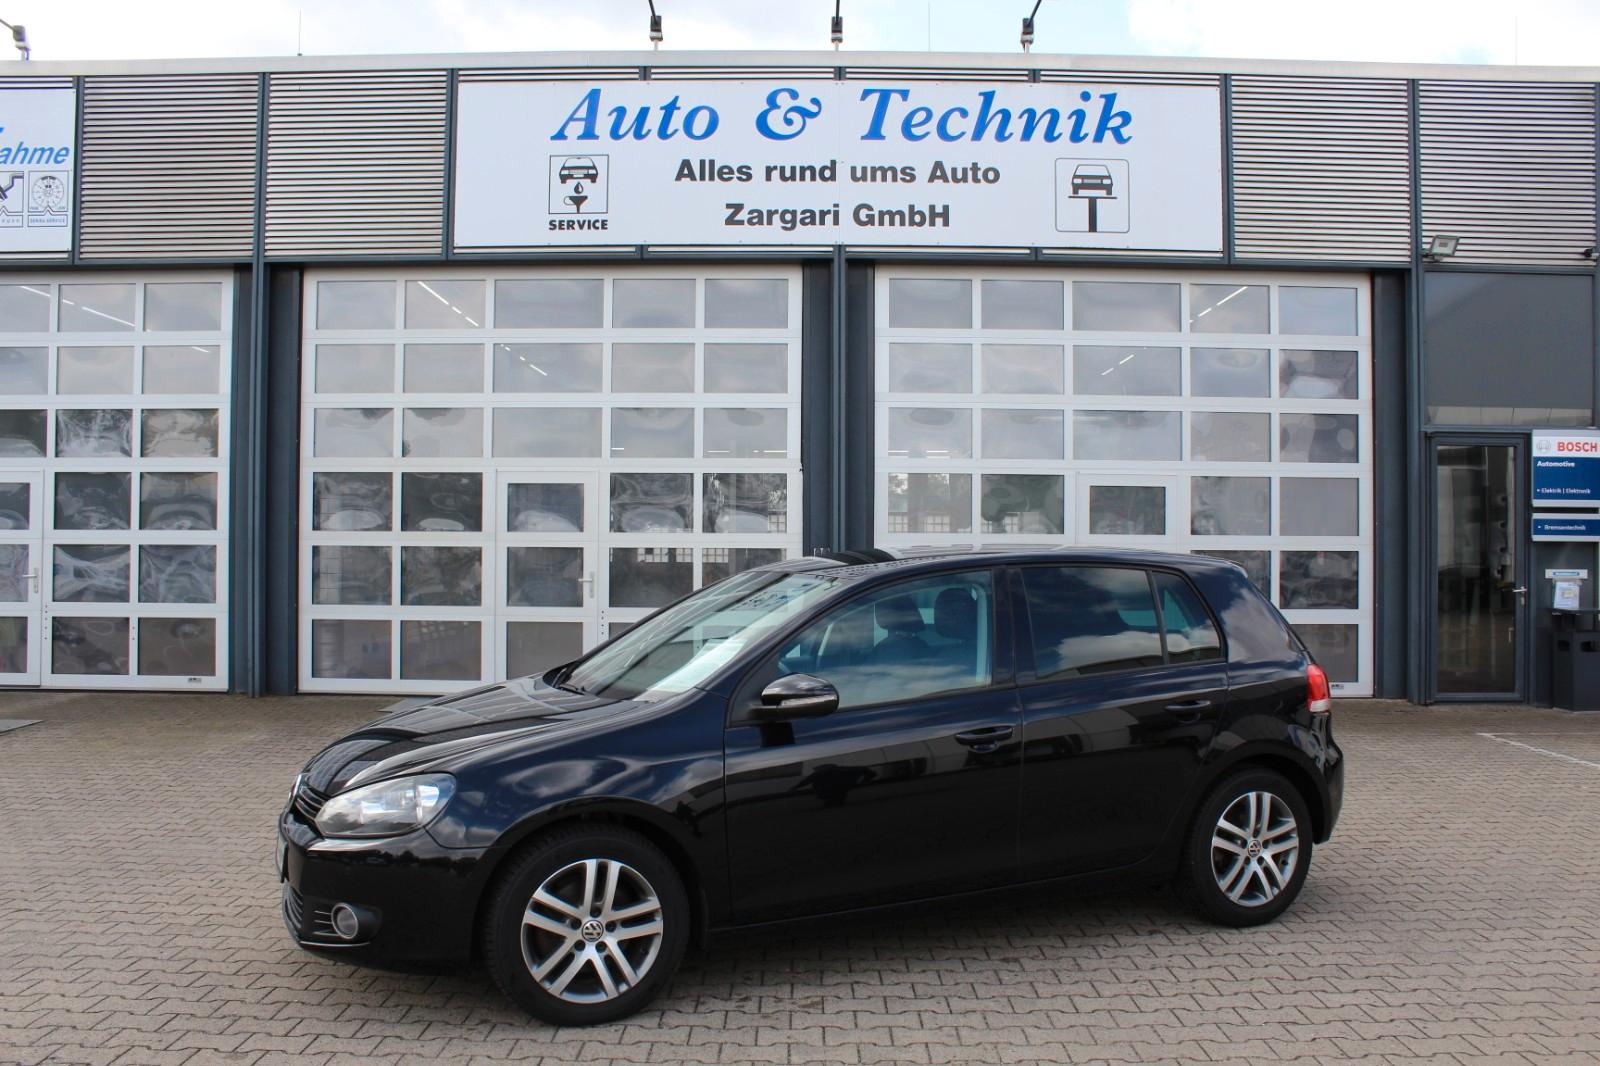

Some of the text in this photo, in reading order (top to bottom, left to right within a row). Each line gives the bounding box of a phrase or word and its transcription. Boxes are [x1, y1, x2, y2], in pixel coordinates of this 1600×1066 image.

[550, 87, 1133, 145] Auto & Technik
[674, 158, 1001, 184] Alles rund ums Auto
[548, 219, 608, 231] SERVICE
[724, 202, 950, 232] Zargari GmbH
[1557, 442, 1598, 452] BOSCH
